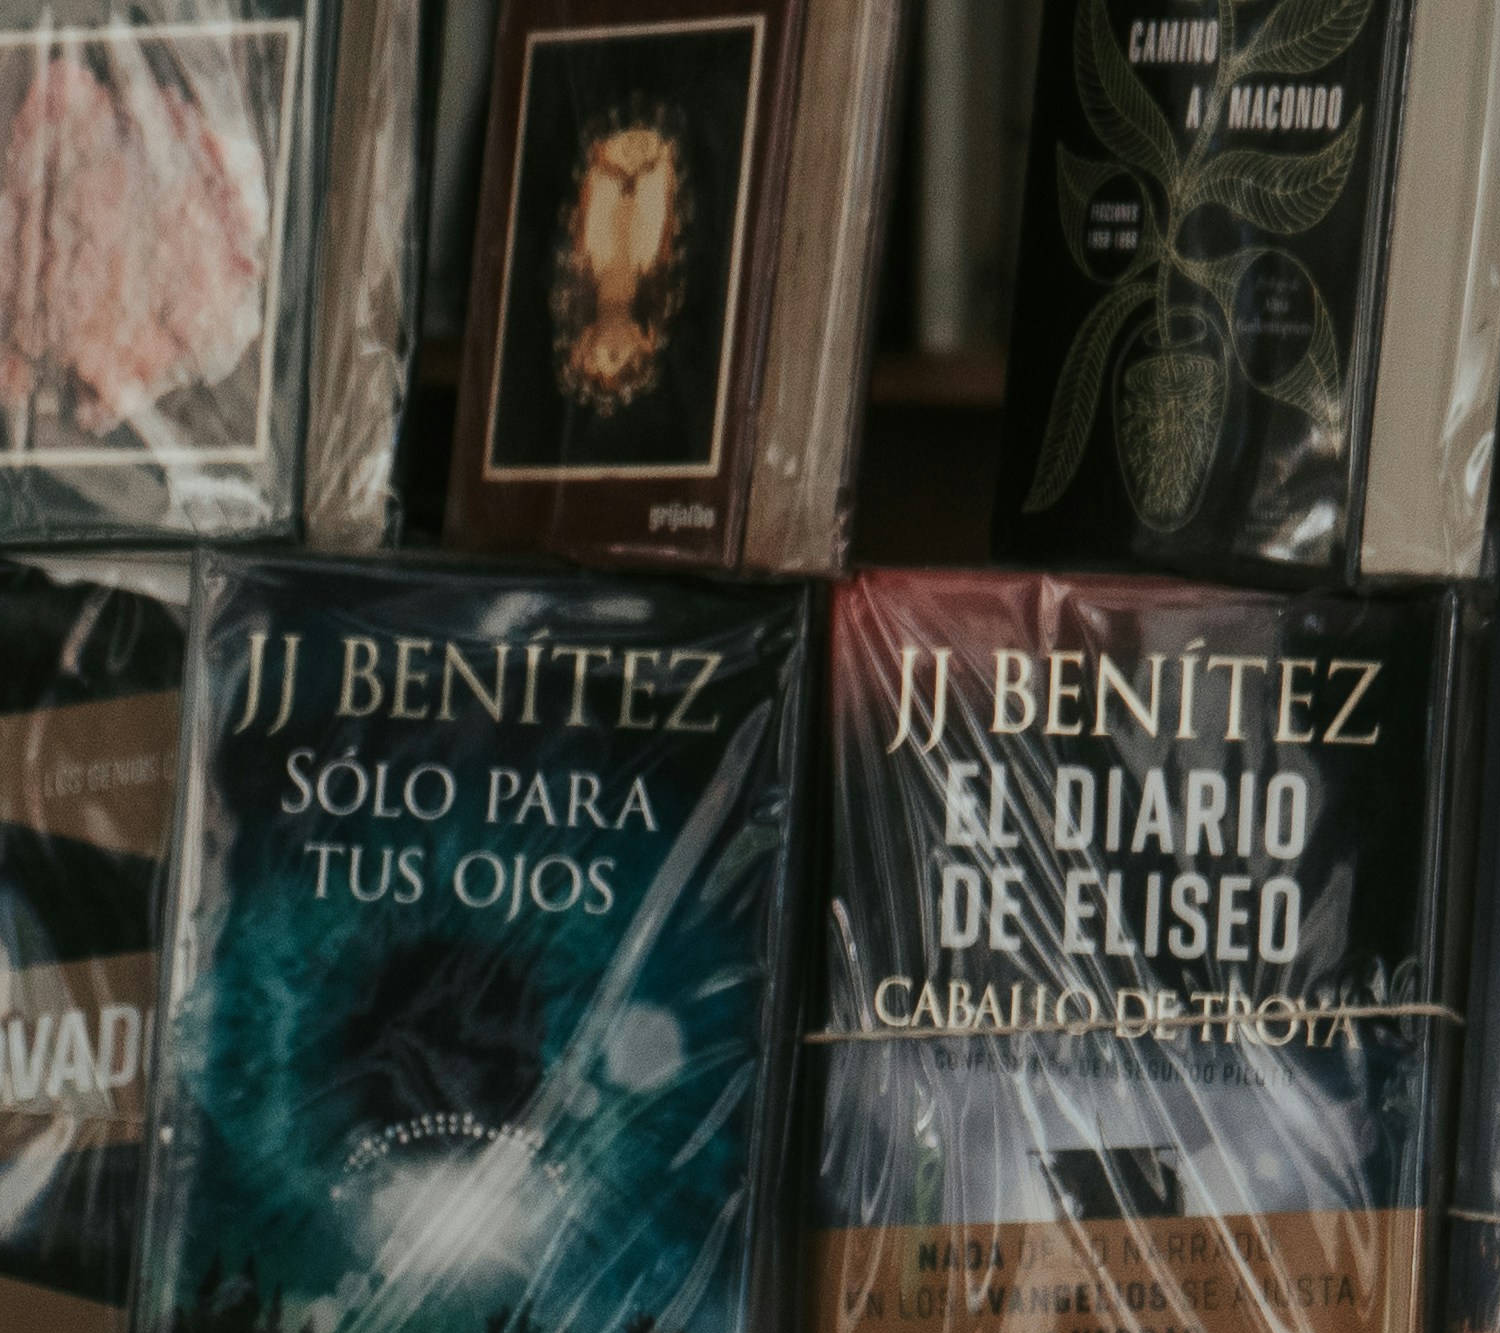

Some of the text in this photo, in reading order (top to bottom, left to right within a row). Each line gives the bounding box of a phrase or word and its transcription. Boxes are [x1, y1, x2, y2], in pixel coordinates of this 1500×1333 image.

[1127, 18, 1220, 65] CAMINO
[1184, 84, 1344, 131] A MACONDO
[235, 628, 723, 739] JJ BENÍTEZ
[886, 640, 1384, 757] JJ BENÍTEZ
[282, 746, 661, 834] SÓLO PARA
[944, 763, 1308, 861] EL DIARIO
[305, 841, 617, 923] TUS OJOS
[939, 867, 1302, 964] DE ELISEO
[874, 974, 1361, 1051] CABALLO DE TROYA
[917, 1240, 1005, 1273] NADA
